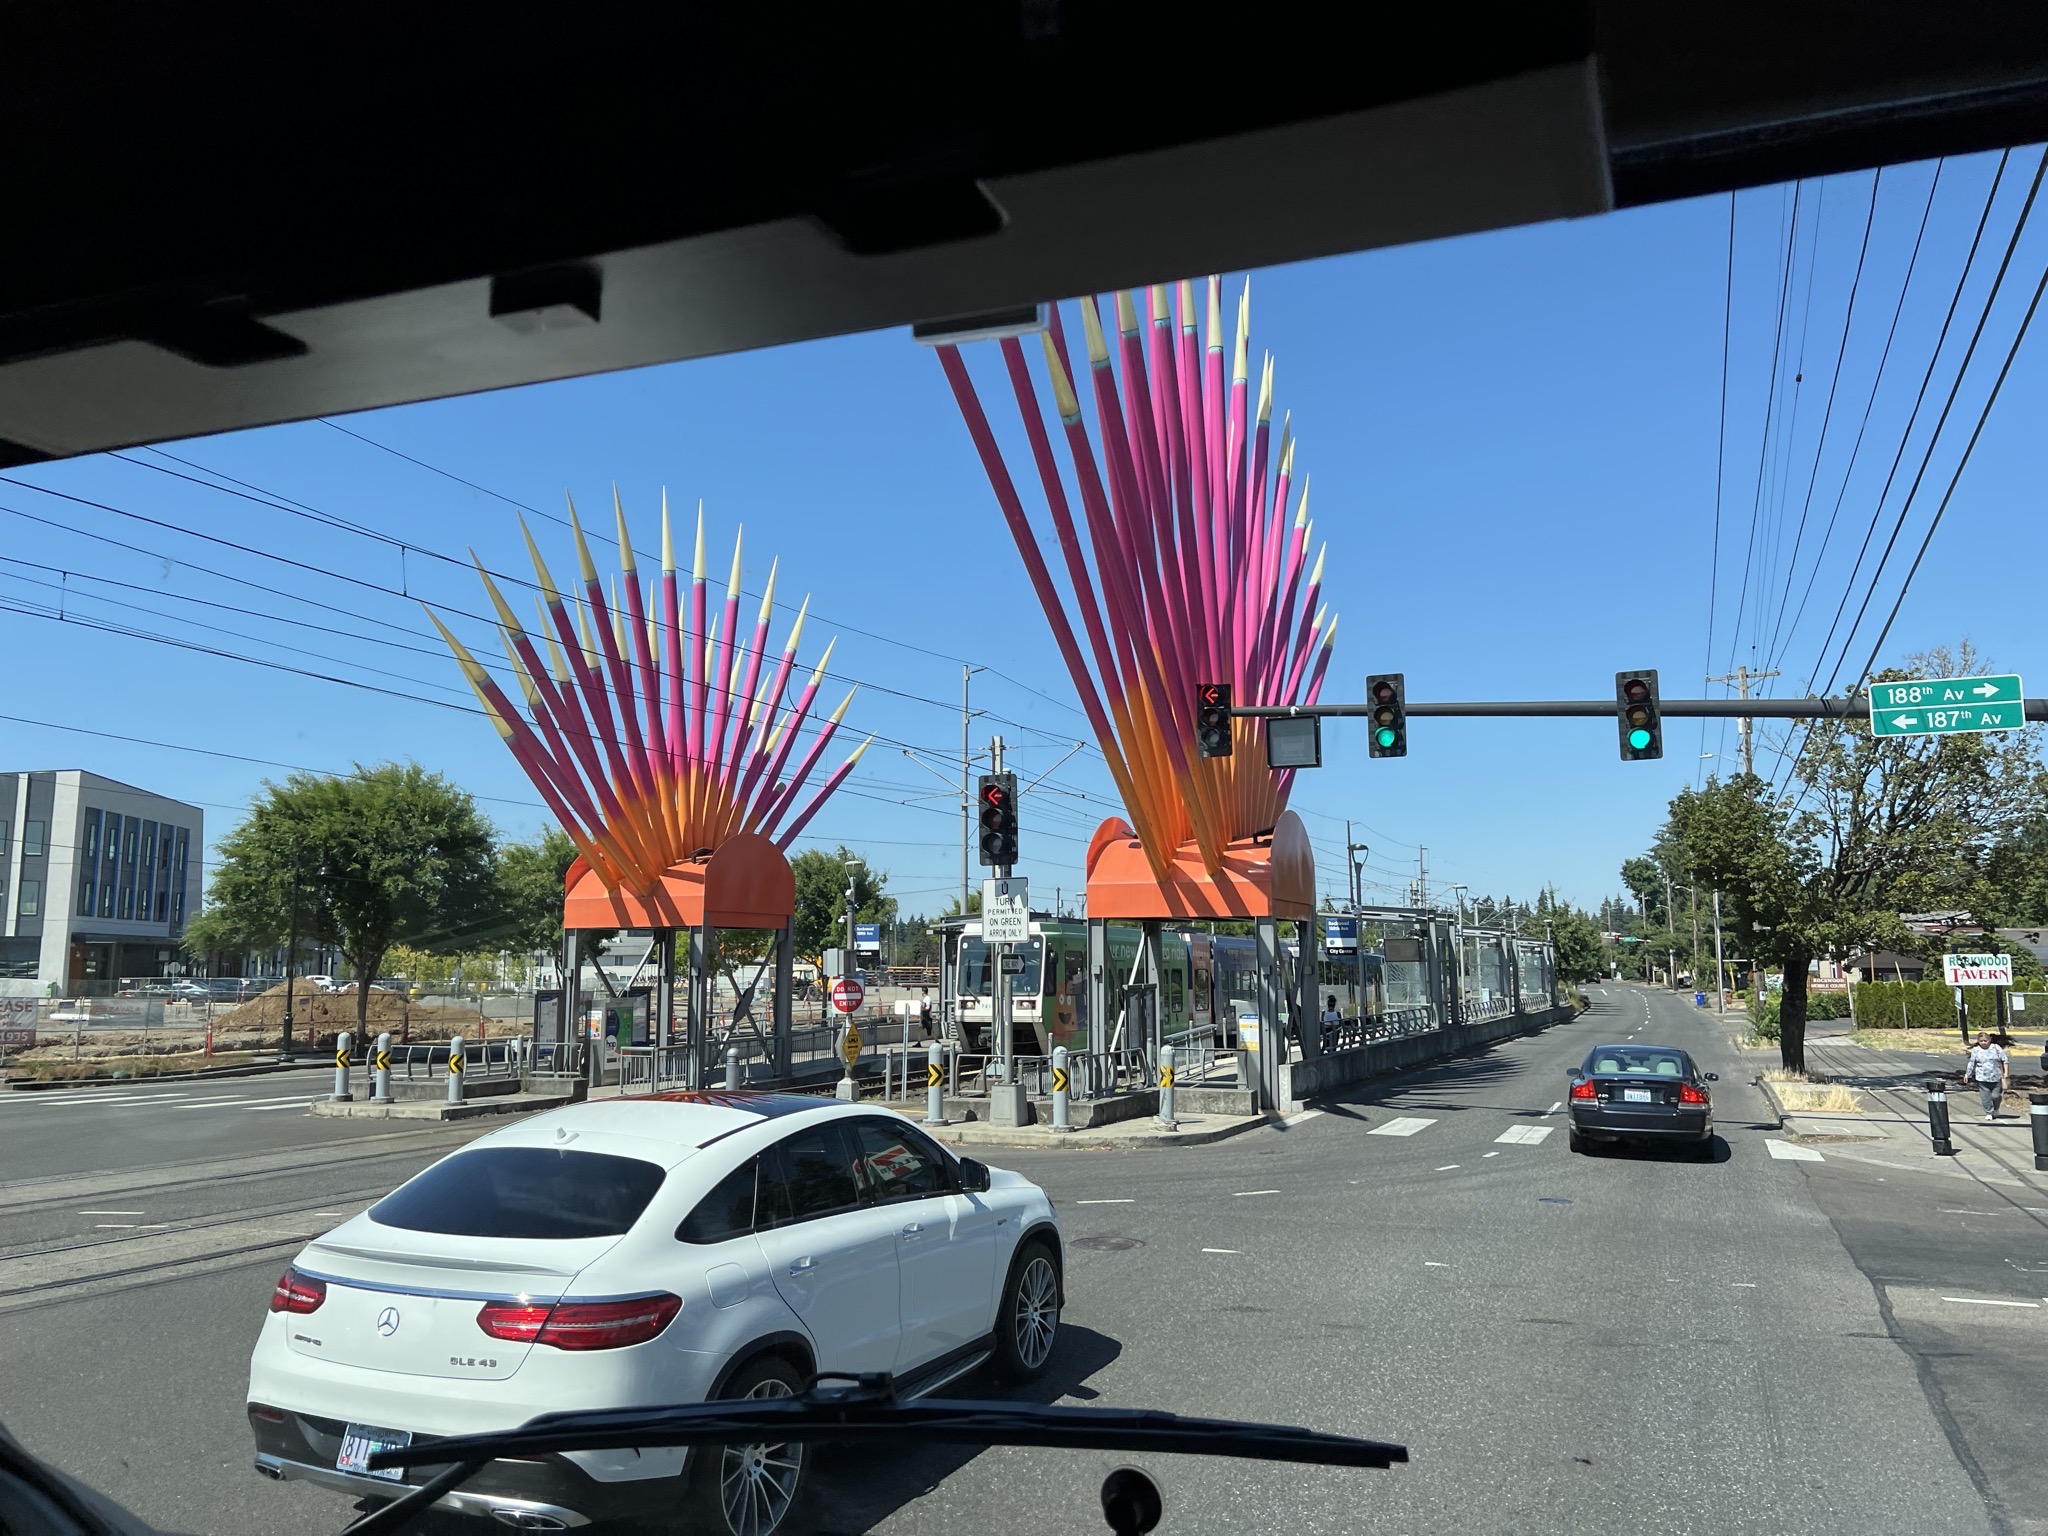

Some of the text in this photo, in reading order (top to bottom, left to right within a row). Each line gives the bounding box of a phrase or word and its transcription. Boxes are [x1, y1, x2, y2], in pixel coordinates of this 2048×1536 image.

[1888, 686, 1964, 705] 188th Av
[1926, 710, 2002, 728] 187th Av
[1001, 883, 1009, 895] U
[995, 897, 1016, 906] TURN
[989, 918, 1022, 926] ON GREEN
[989, 929, 1022, 938] ARROW ONLY
[1950, 966, 2009, 983] TAVERN
